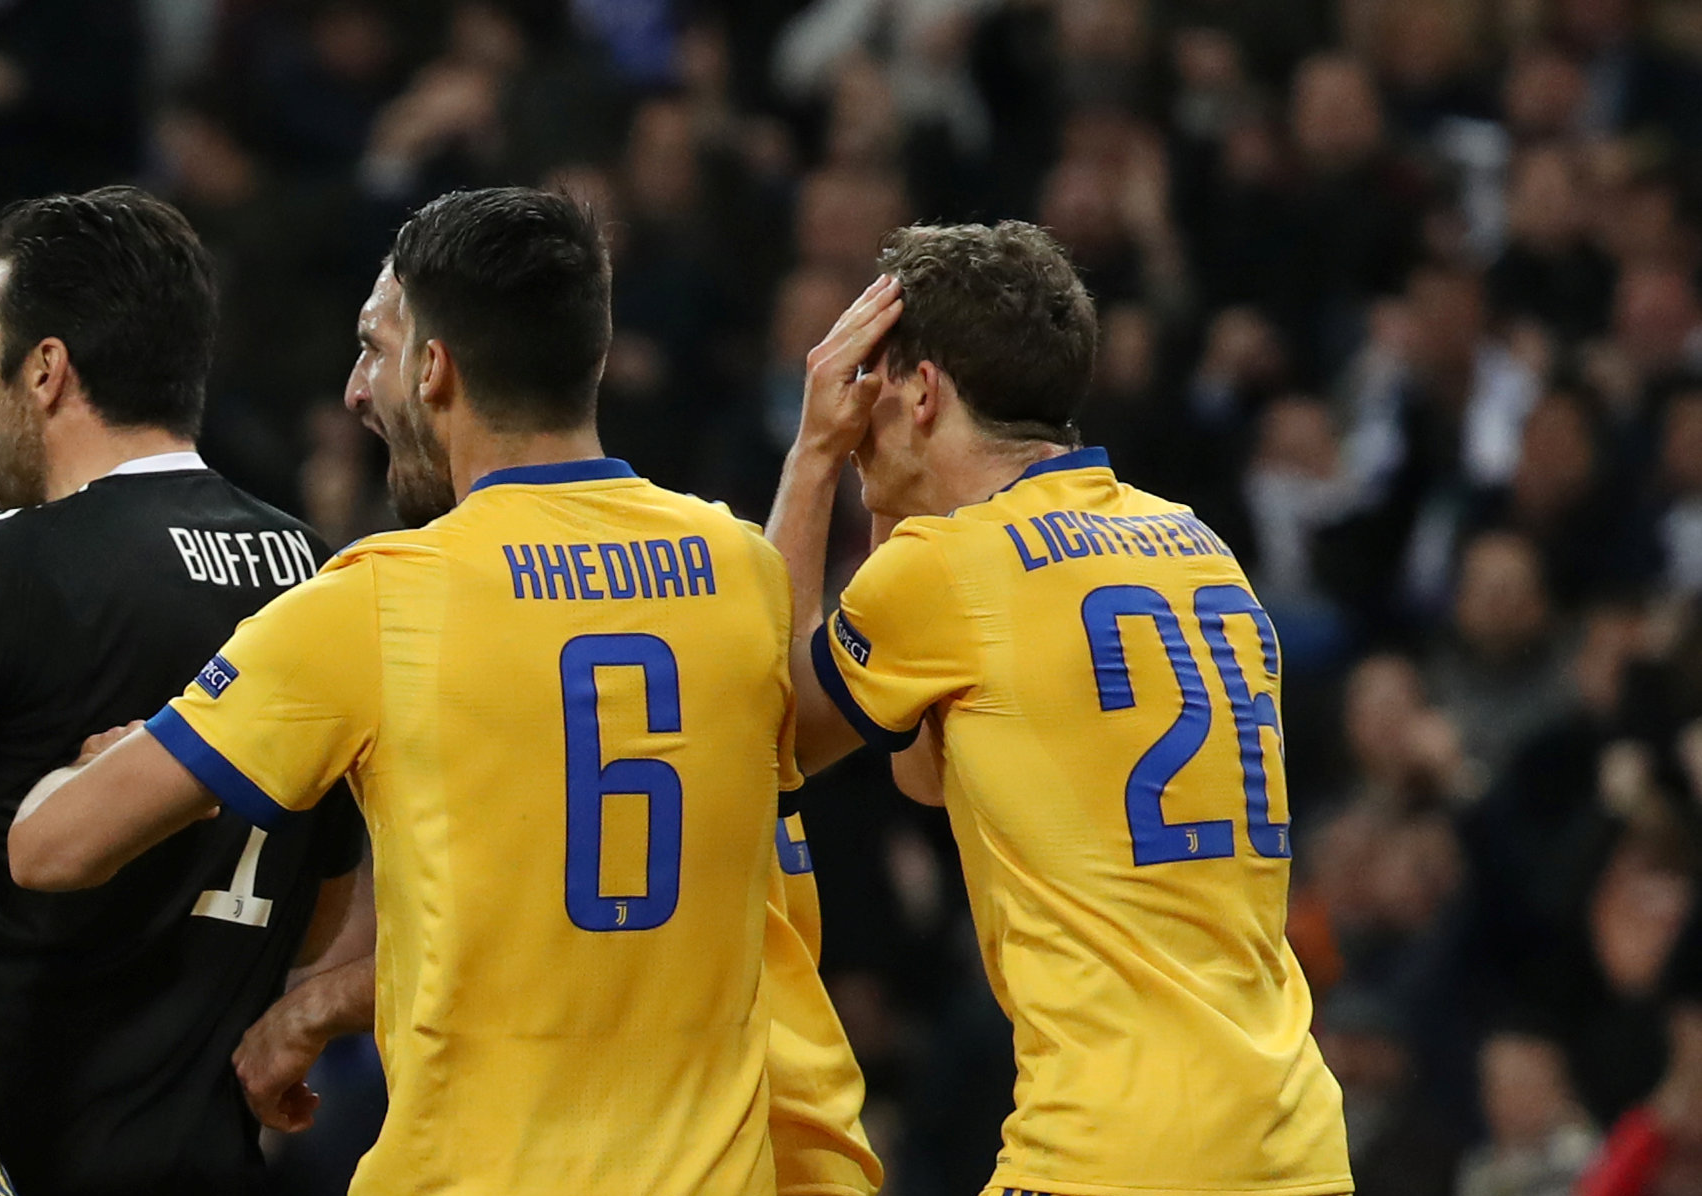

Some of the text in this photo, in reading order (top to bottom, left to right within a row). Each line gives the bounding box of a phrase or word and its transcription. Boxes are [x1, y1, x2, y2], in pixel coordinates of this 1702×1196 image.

[168, 527, 319, 588] BUFFON
[502, 534, 717, 600] KHEDIRA
[836, 616, 868, 663] SPECT
[1081, 584, 1293, 866] 26
[559, 633, 684, 932] 6
[190, 825, 274, 929] 1
